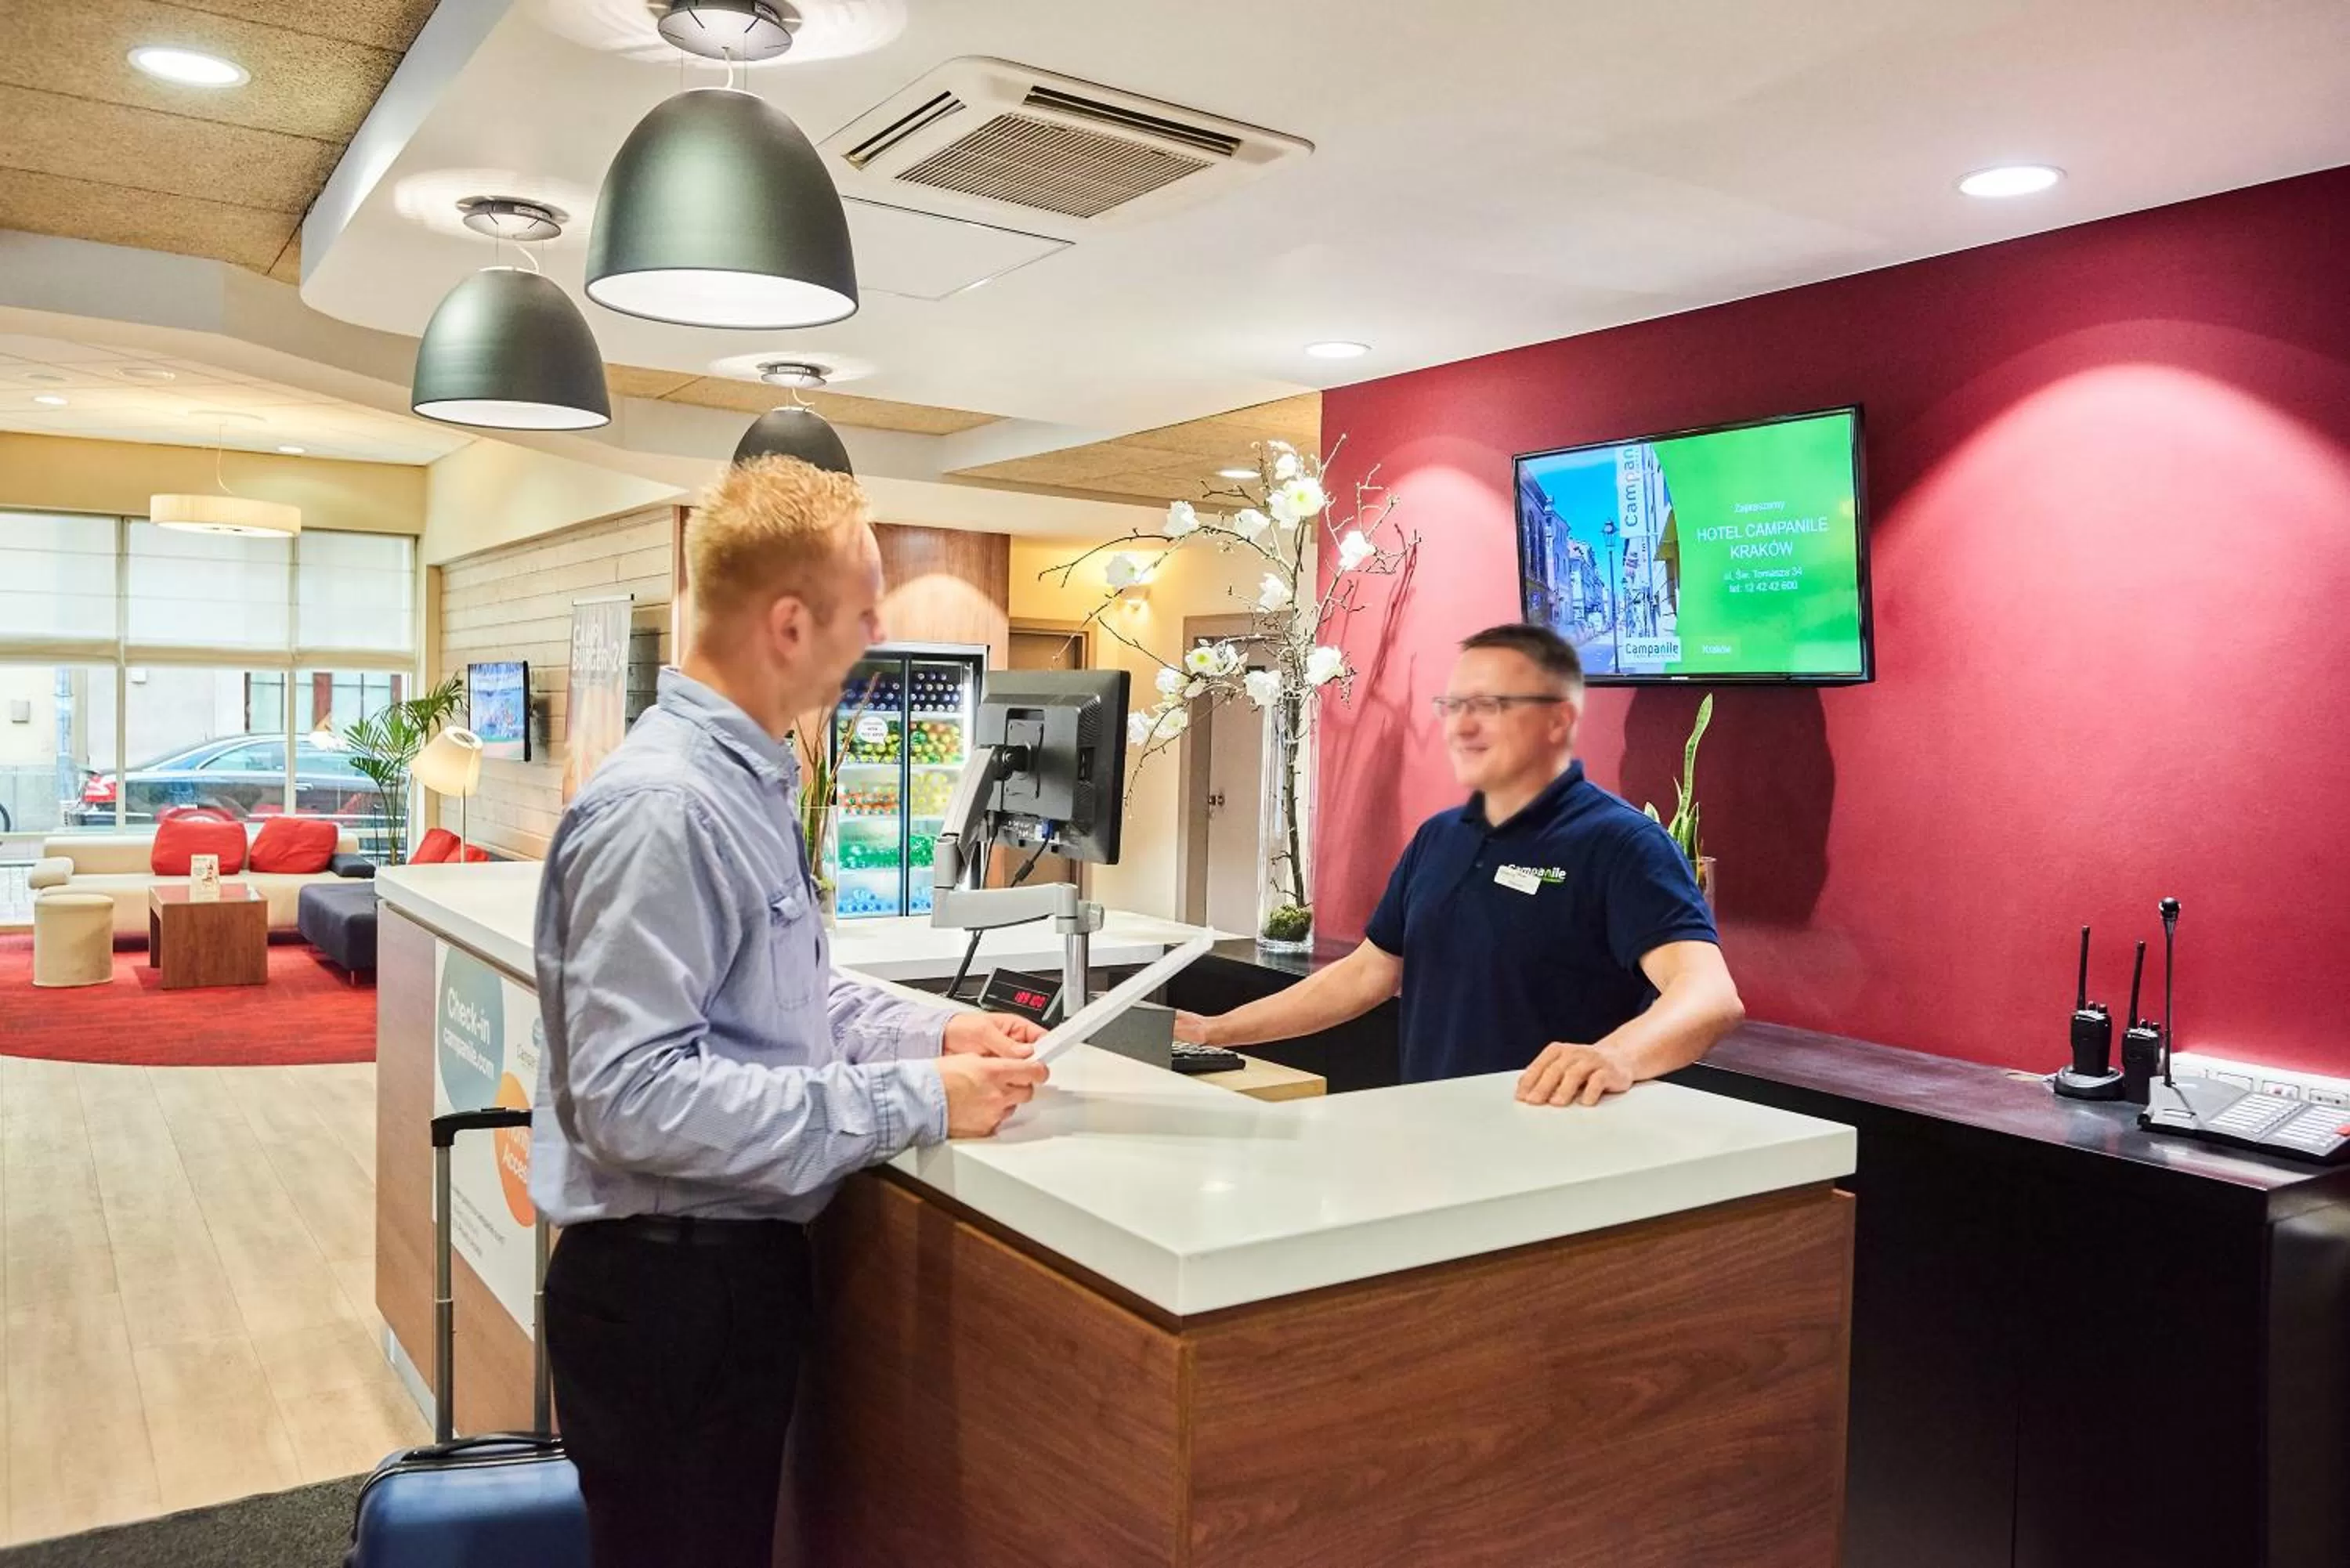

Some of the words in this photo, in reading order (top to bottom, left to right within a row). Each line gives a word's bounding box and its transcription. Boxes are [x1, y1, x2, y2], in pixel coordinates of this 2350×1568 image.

[1697, 526, 1743, 542] HOTEL
[1745, 516, 1829, 538] CAMPANILE
[1730, 540, 1794, 559] KRAKÓW
[1625, 641, 1679, 658] Campanile
[447, 987, 490, 1046] Check-in
[443, 1027, 495, 1081] campanile.com
